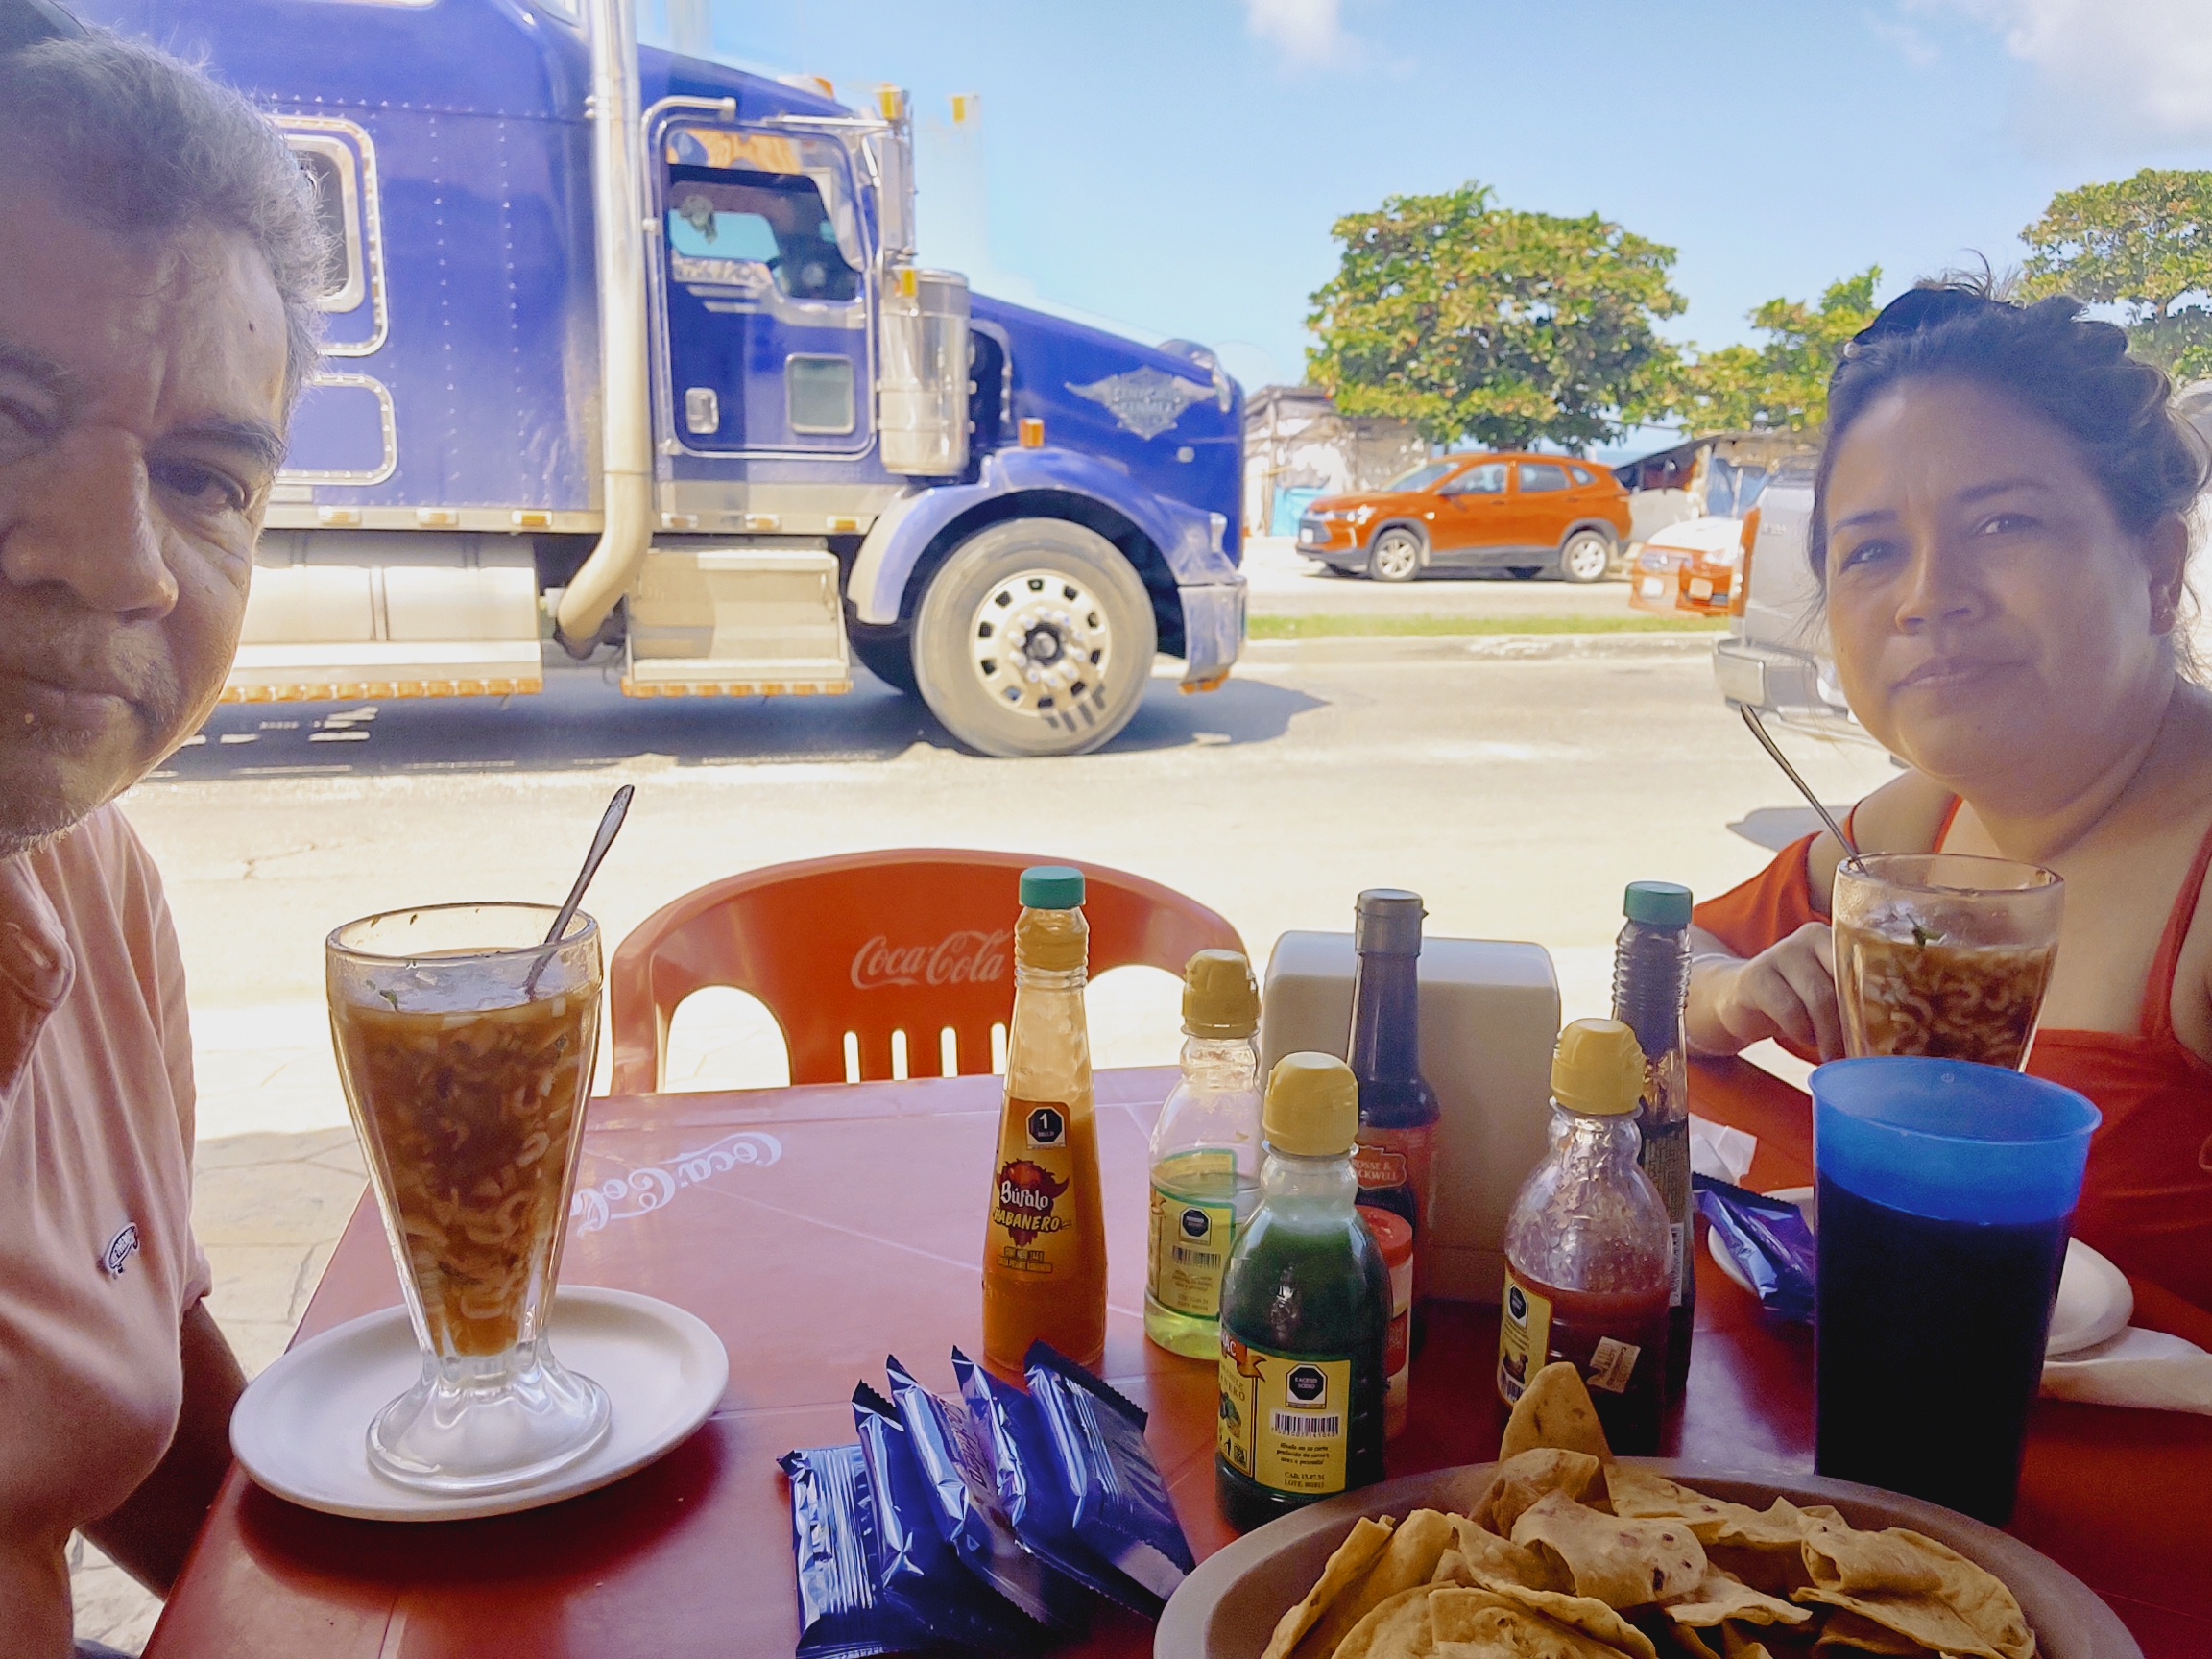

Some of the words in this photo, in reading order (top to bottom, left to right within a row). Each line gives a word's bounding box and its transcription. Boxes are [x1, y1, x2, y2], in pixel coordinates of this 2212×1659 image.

[850, 929, 1013, 990] Coca-Cola
[1039, 1112, 1048, 1130] 1
[1352, 1158, 1381, 1170] ROSSE
[1358, 1168, 1398, 1182] CKWELL
[1000, 1179, 1050, 1211] Búfalo
[994, 1207, 1061, 1232] HABANERO
